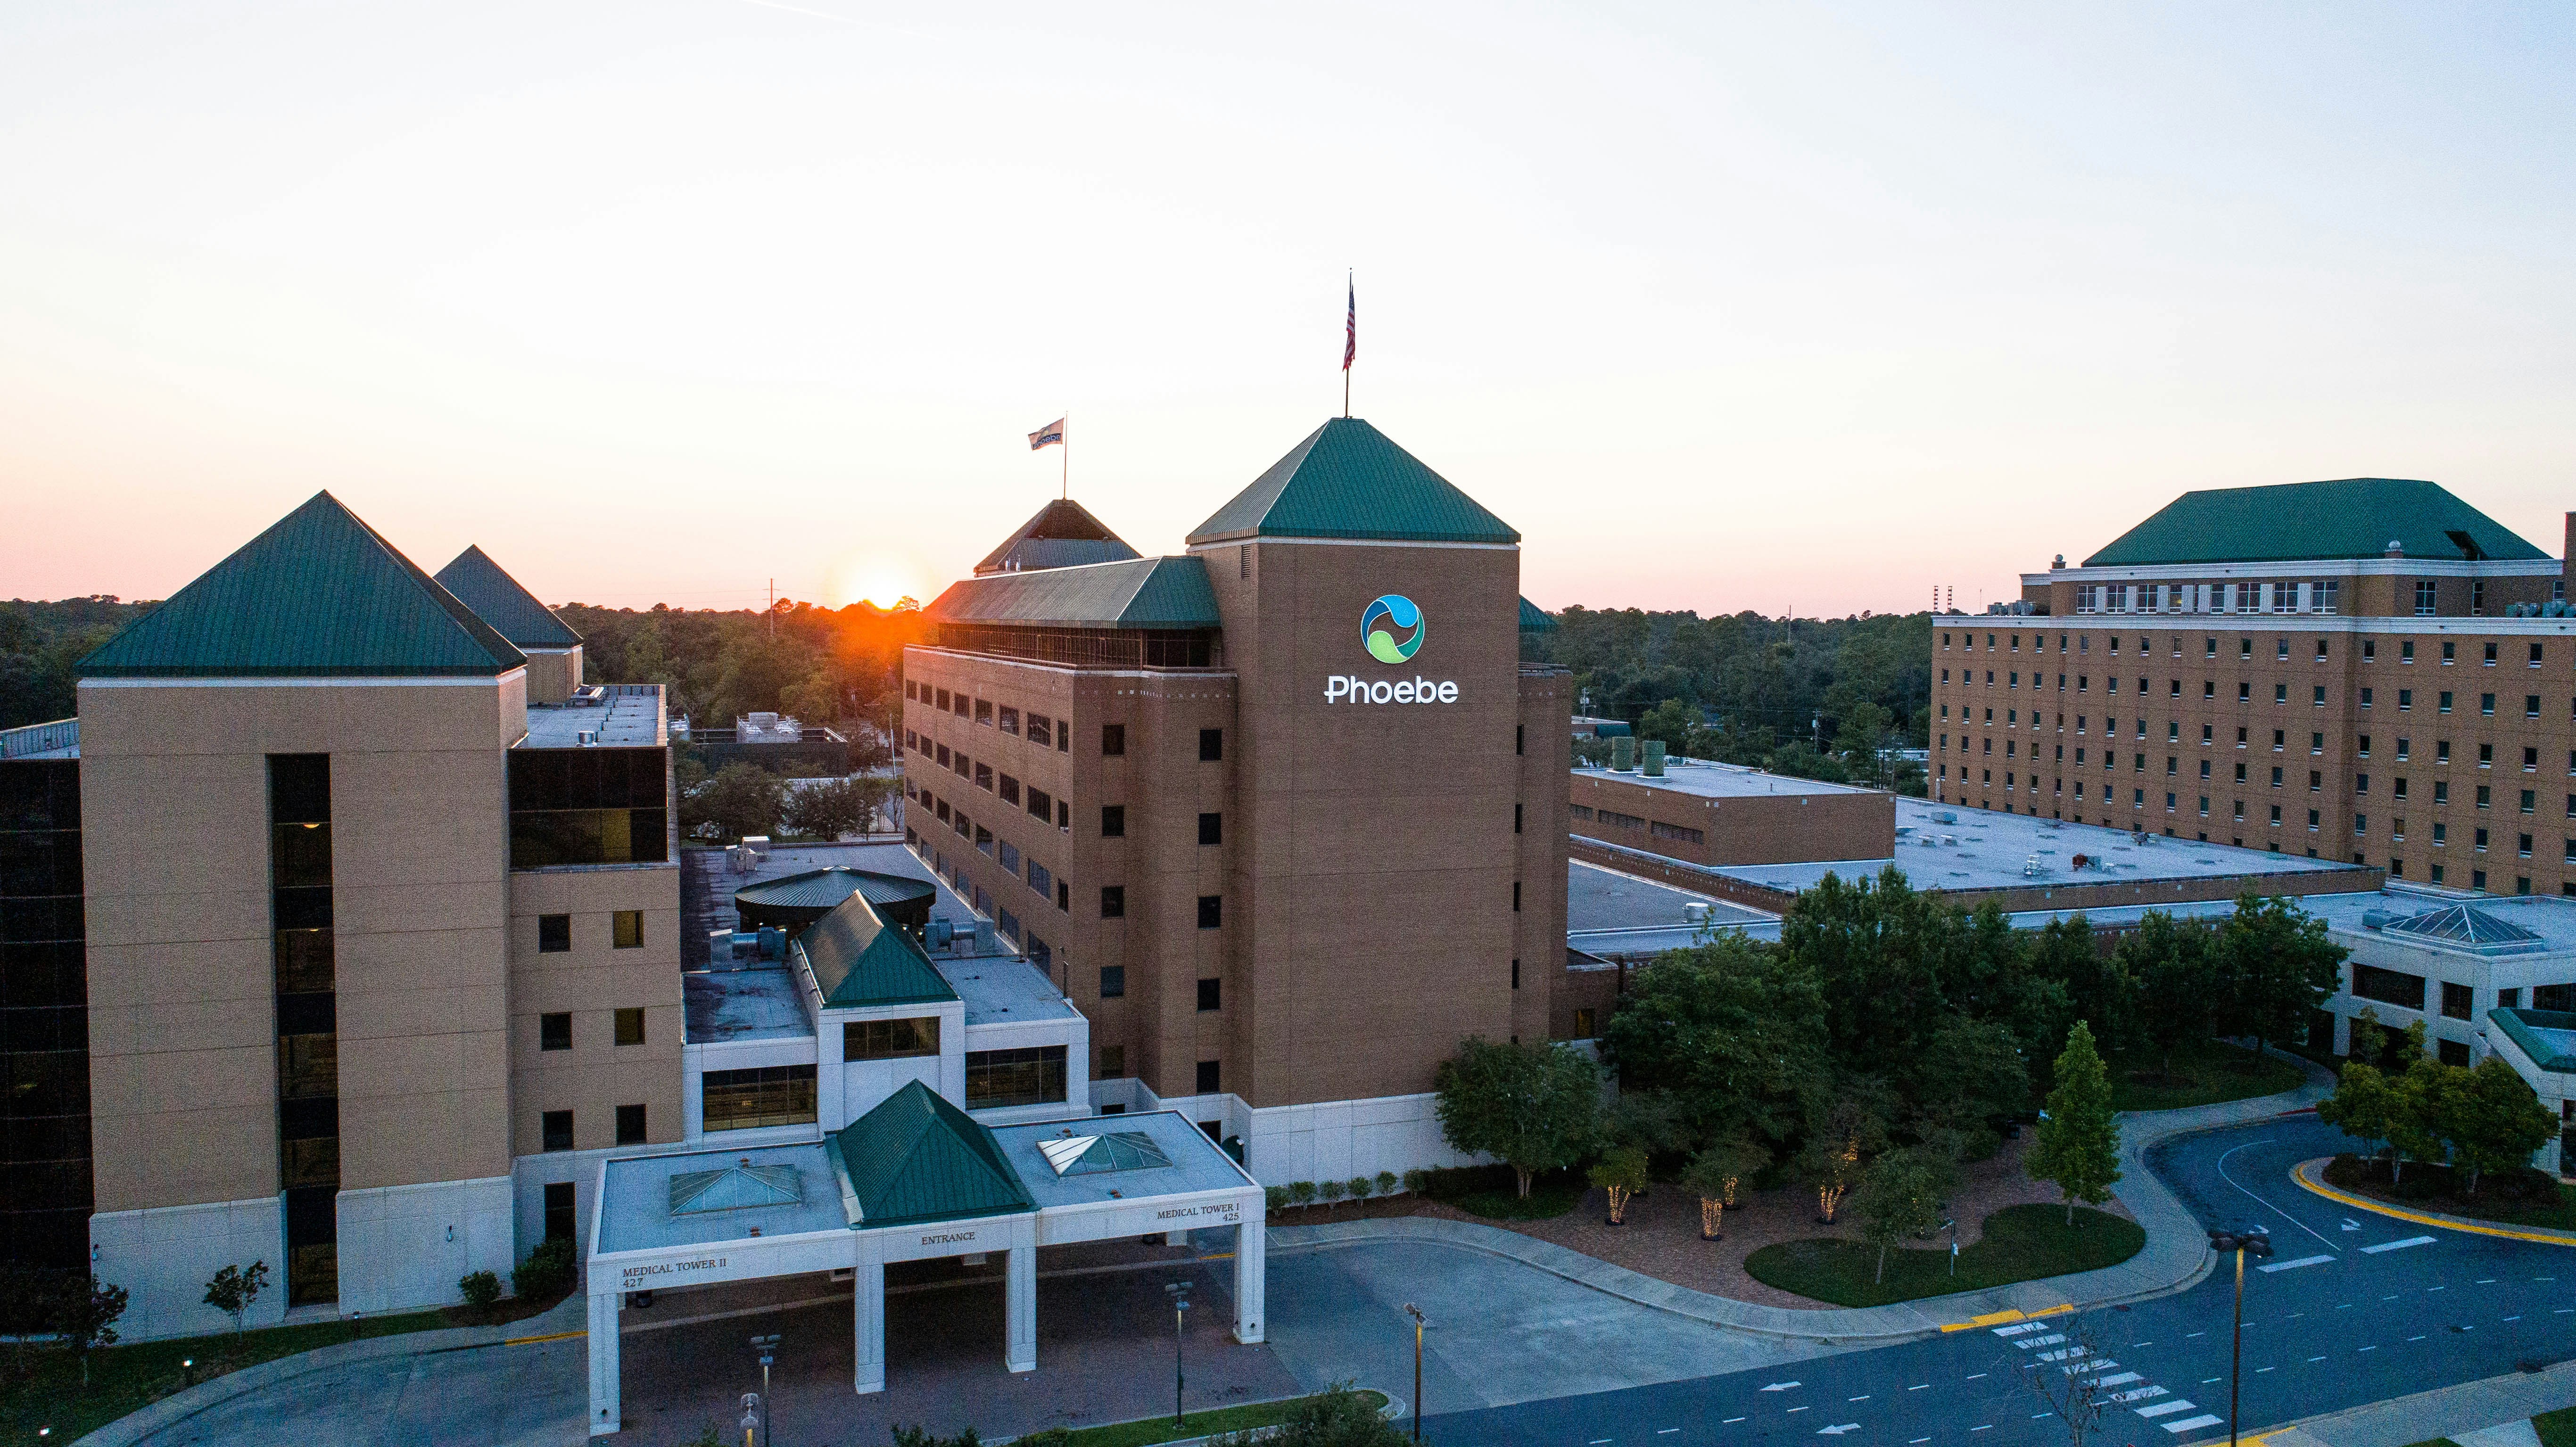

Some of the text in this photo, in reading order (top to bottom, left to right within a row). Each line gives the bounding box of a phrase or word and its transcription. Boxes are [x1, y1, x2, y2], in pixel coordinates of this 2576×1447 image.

[1324, 675, 1458, 704] Phoebe
[1157, 1208, 1198, 1219] MEDICAL
[1201, 1204, 1233, 1214] TOWER
[1223, 1213, 1239, 1221] 425
[922, 1232, 975, 1245] ENTRANCE
[623, 1258, 727, 1277] MEDICAL TOWER II
[623, 1278, 643, 1287] 427
